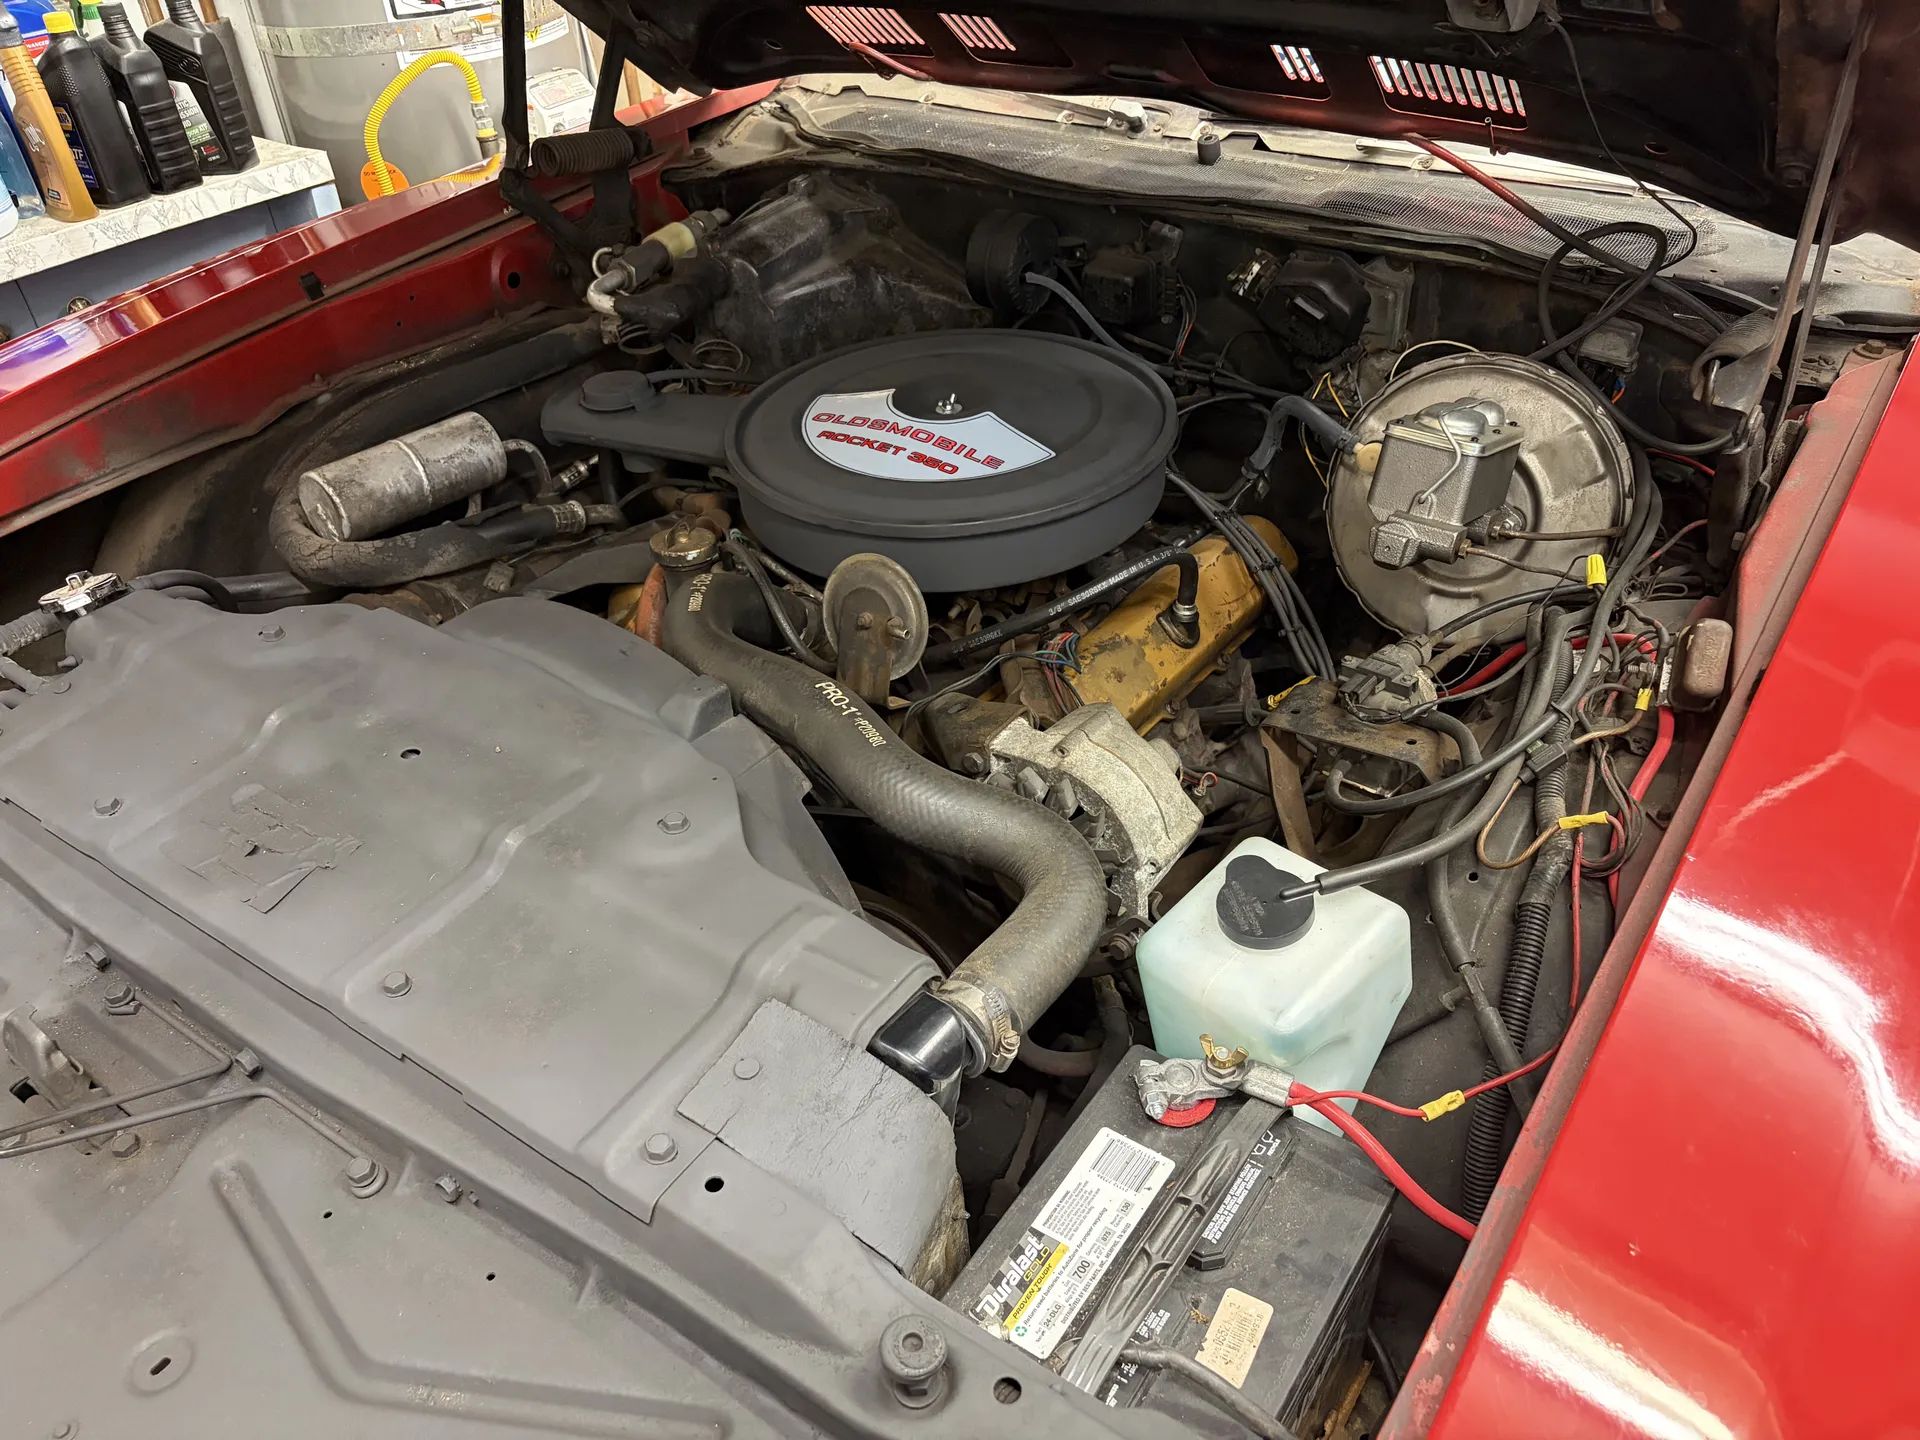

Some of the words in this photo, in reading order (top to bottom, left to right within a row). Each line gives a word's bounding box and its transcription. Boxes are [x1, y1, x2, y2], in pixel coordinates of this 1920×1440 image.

[812, 413, 1005, 469] OLDSMOBILE
[817, 430, 907, 456] ROCKET
[906, 450, 960, 476] 350
[1108, 570, 1130, 587] MADE
[1121, 1201, 1130, 1213] 130
[976, 1232, 1042, 1321] Duralast
[1023, 1245, 1050, 1281] GOLD
[1023, 1307, 1038, 1325] Return
[1035, 1295, 1045, 1307] used
[1043, 1275, 1059, 1296] batteries
[1061, 1247, 1079, 1270] AutoZone
[1076, 1240, 1084, 1248] for
[1082, 1225, 1095, 1241] proper
[1072, 1259, 1090, 1279] 700
[1012, 1288, 1035, 1318] PROVEN
[1033, 1263, 1052, 1288] TOUGH
[1043, 1303, 1061, 1327] 24-DLG
